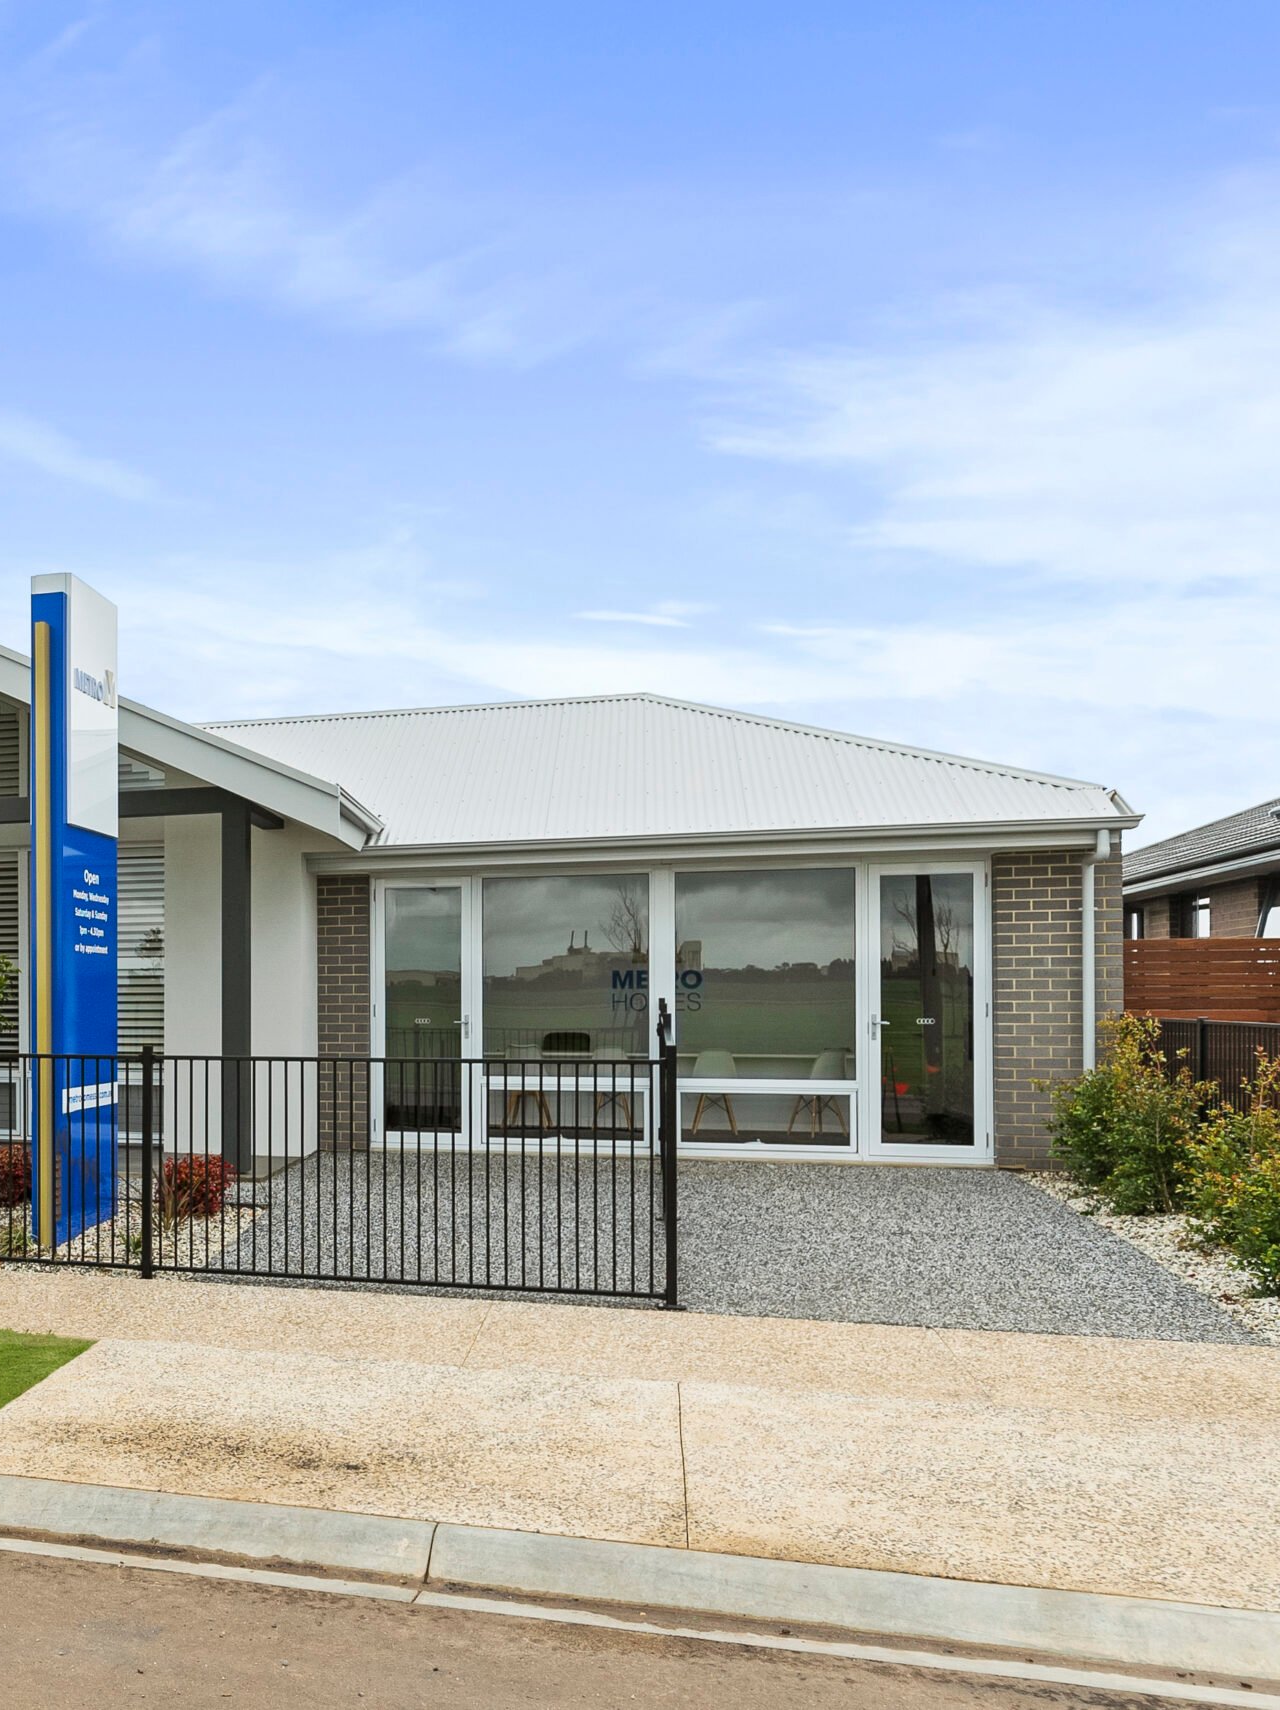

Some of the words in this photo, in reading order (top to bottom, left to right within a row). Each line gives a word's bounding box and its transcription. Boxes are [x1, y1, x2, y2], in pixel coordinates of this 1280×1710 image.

[73, 667, 103, 702] METRO
[84, 869, 99, 886] Open
[75, 907, 91, 920] Saturday
[95, 910, 108, 922] Sunday
[80, 942, 86, 954] by
[86, 944, 108, 954] appointment
[612, 969, 703, 990] MEO
[612, 992, 702, 1012] HOES
